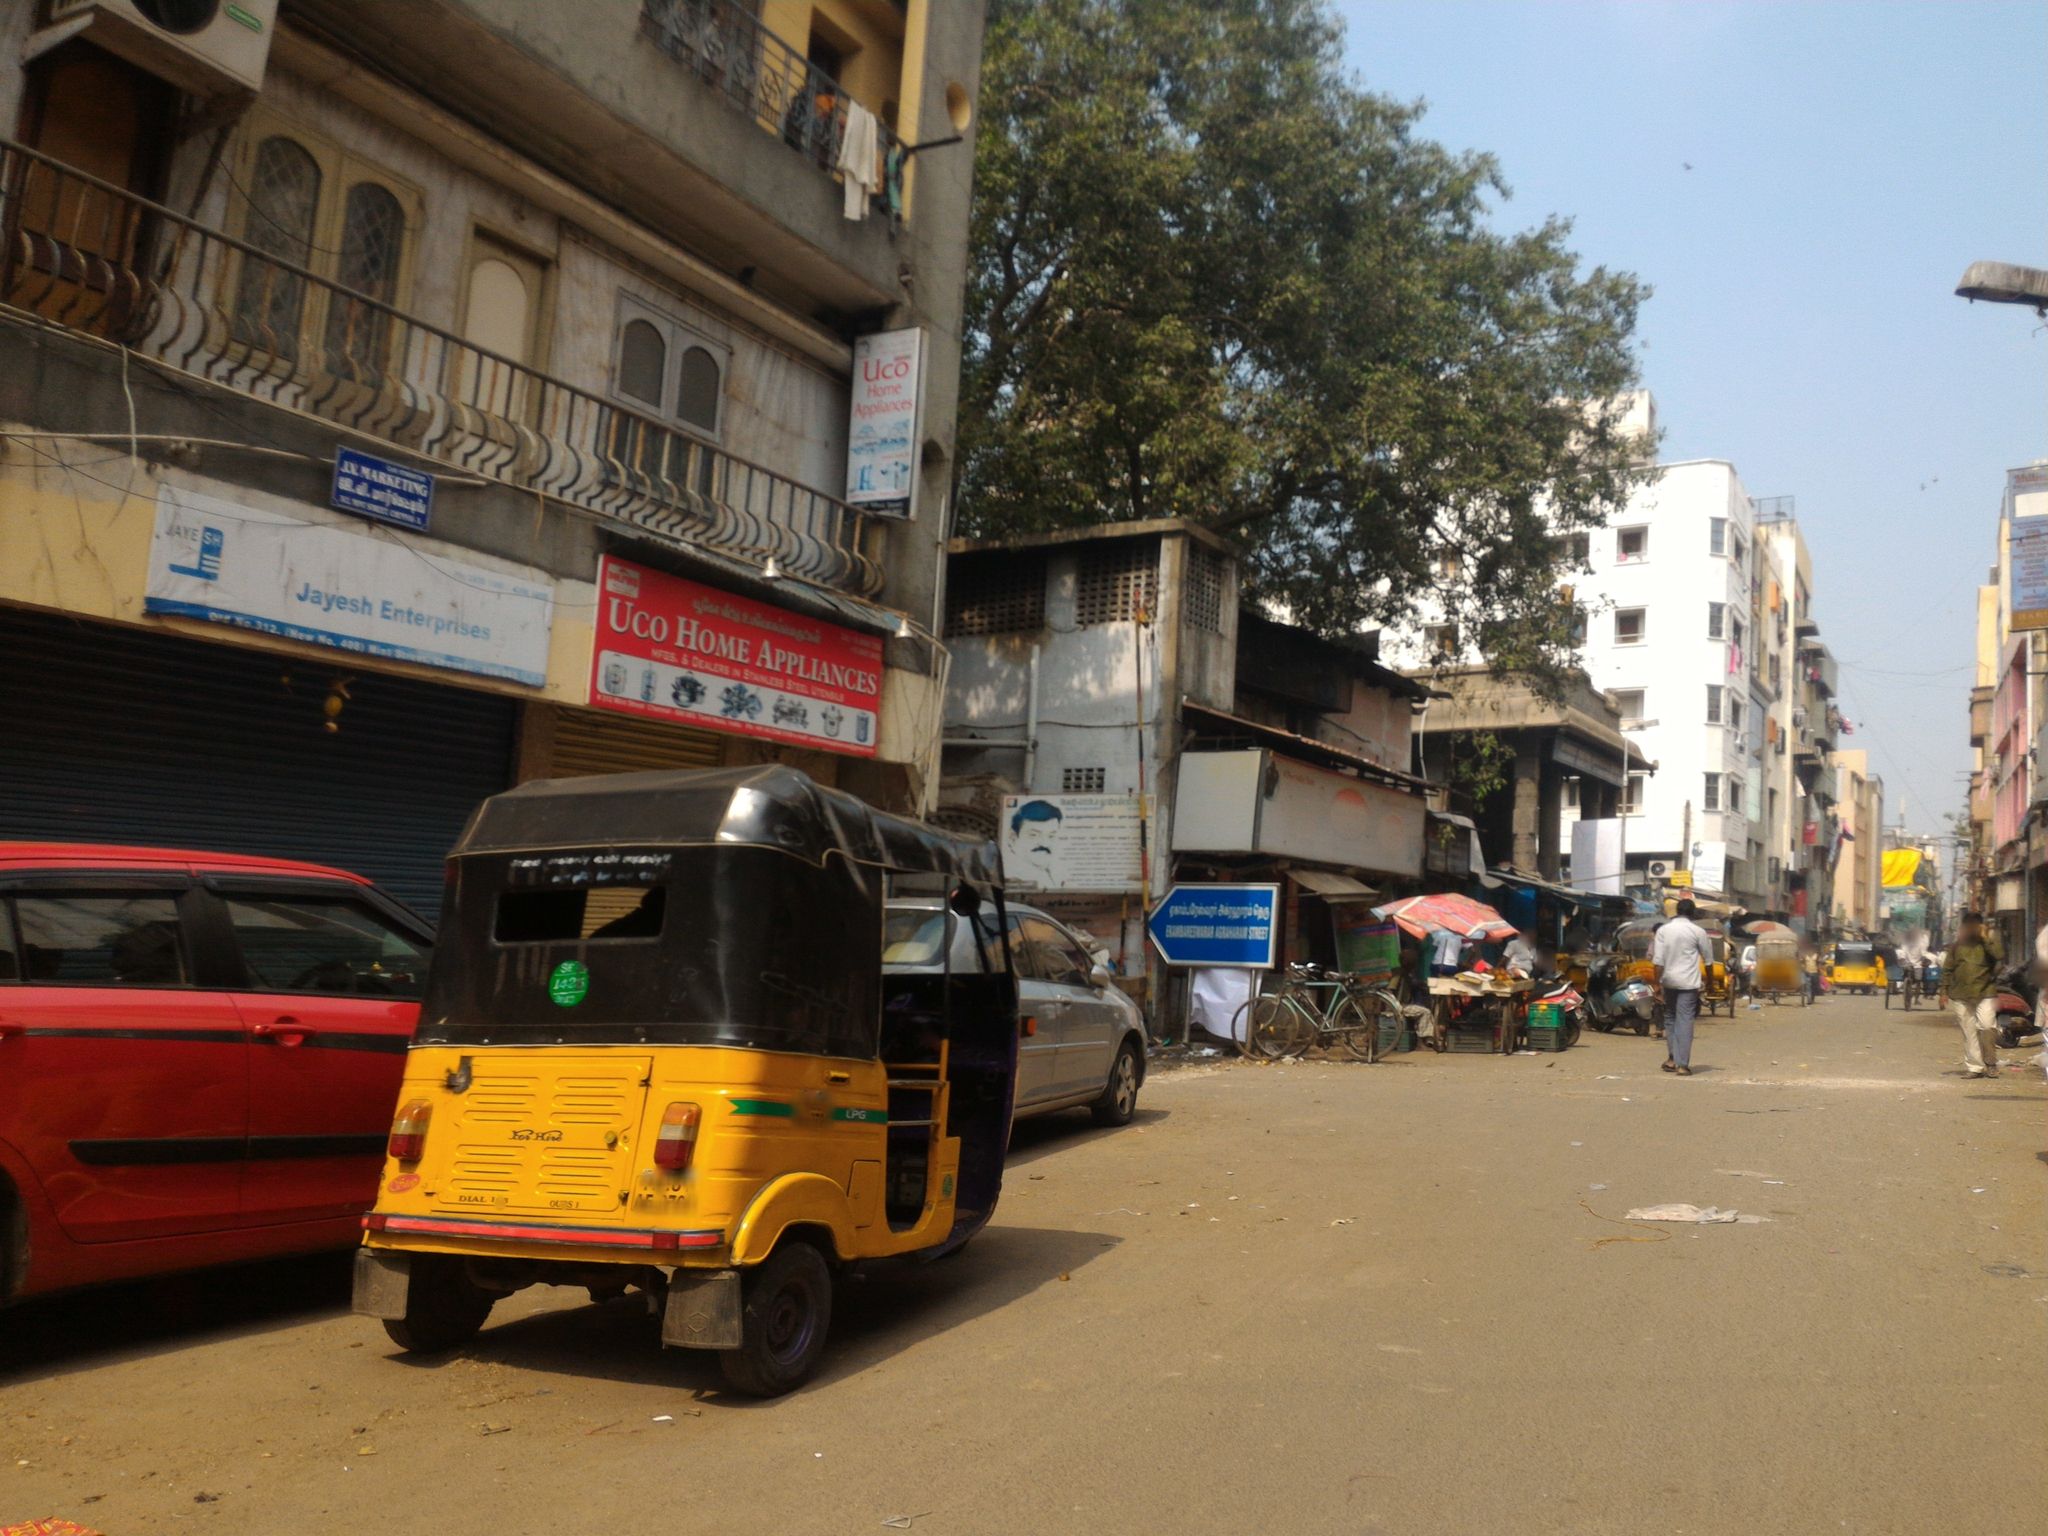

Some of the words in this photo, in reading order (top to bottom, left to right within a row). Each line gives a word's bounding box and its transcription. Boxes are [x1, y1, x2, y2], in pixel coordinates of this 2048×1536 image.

[360, 465, 429, 498] MARKETING
[166, 526, 221, 545] JAYESH
[296, 582, 373, 616] Jayesh
[379, 600, 491, 640] Enterprises
[845, 1109, 867, 1120] LPG
[458, 1194, 488, 1203] DIAL
